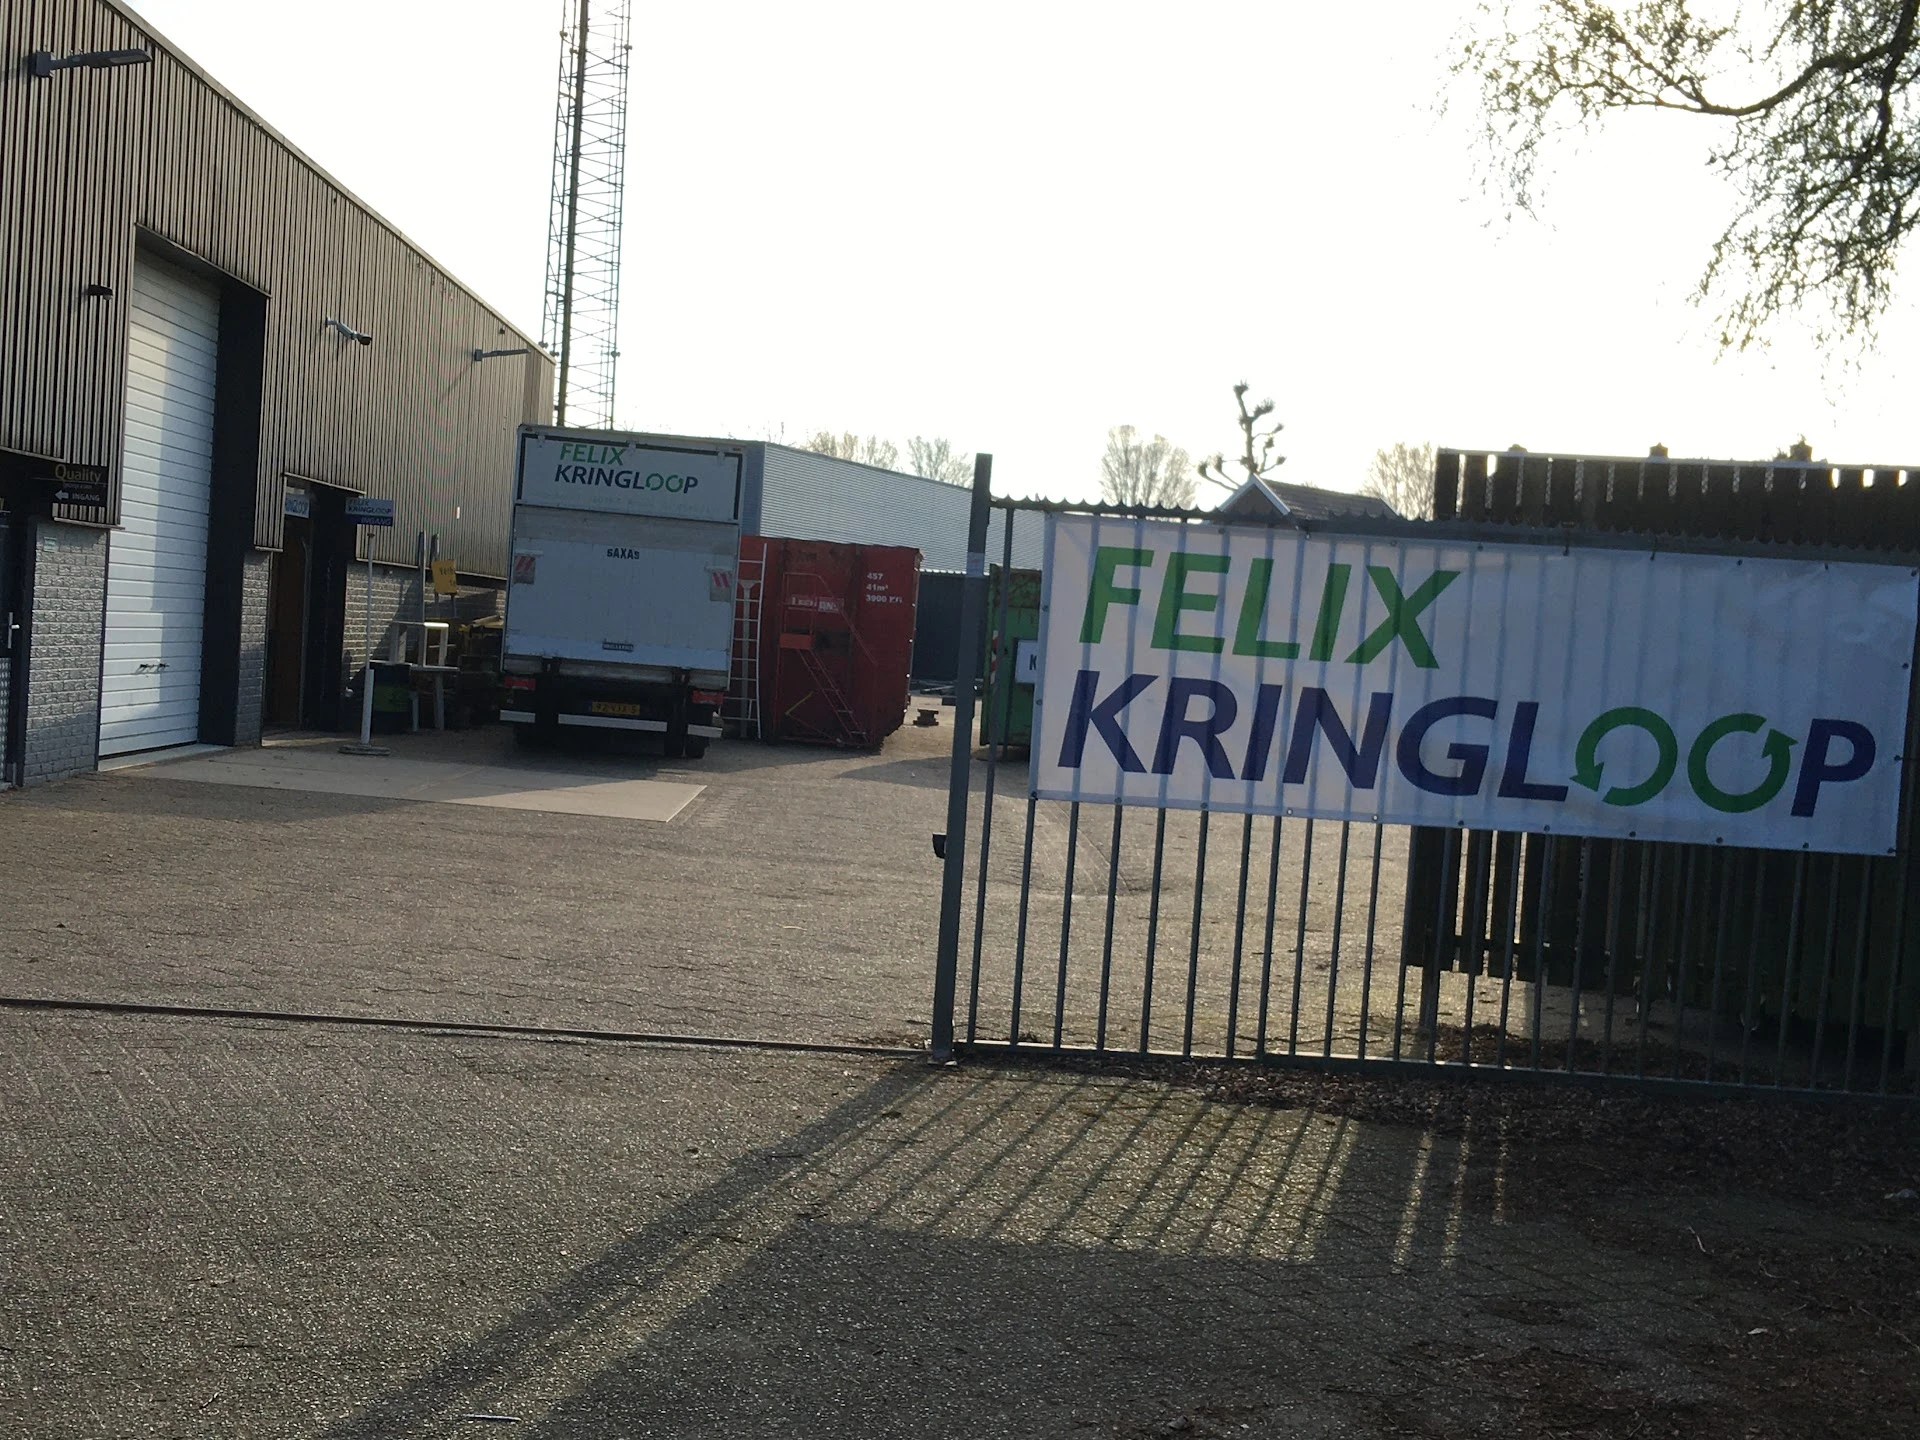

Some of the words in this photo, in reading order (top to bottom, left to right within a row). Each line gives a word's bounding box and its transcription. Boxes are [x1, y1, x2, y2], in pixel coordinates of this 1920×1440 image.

[559, 442, 626, 466] FELIX
[55, 463, 102, 486] Quality
[554, 464, 699, 494] KRINGLOOP
[72, 492, 100, 502] INGANG
[348, 505, 392, 515] KRINGLOOP
[360, 516, 392, 525] INGANG
[866, 572, 884, 581] 457
[865, 594, 887, 603] 3900
[1078, 545, 1462, 670] FELIX
[1057, 669, 1877, 818] KRINGLOOP
